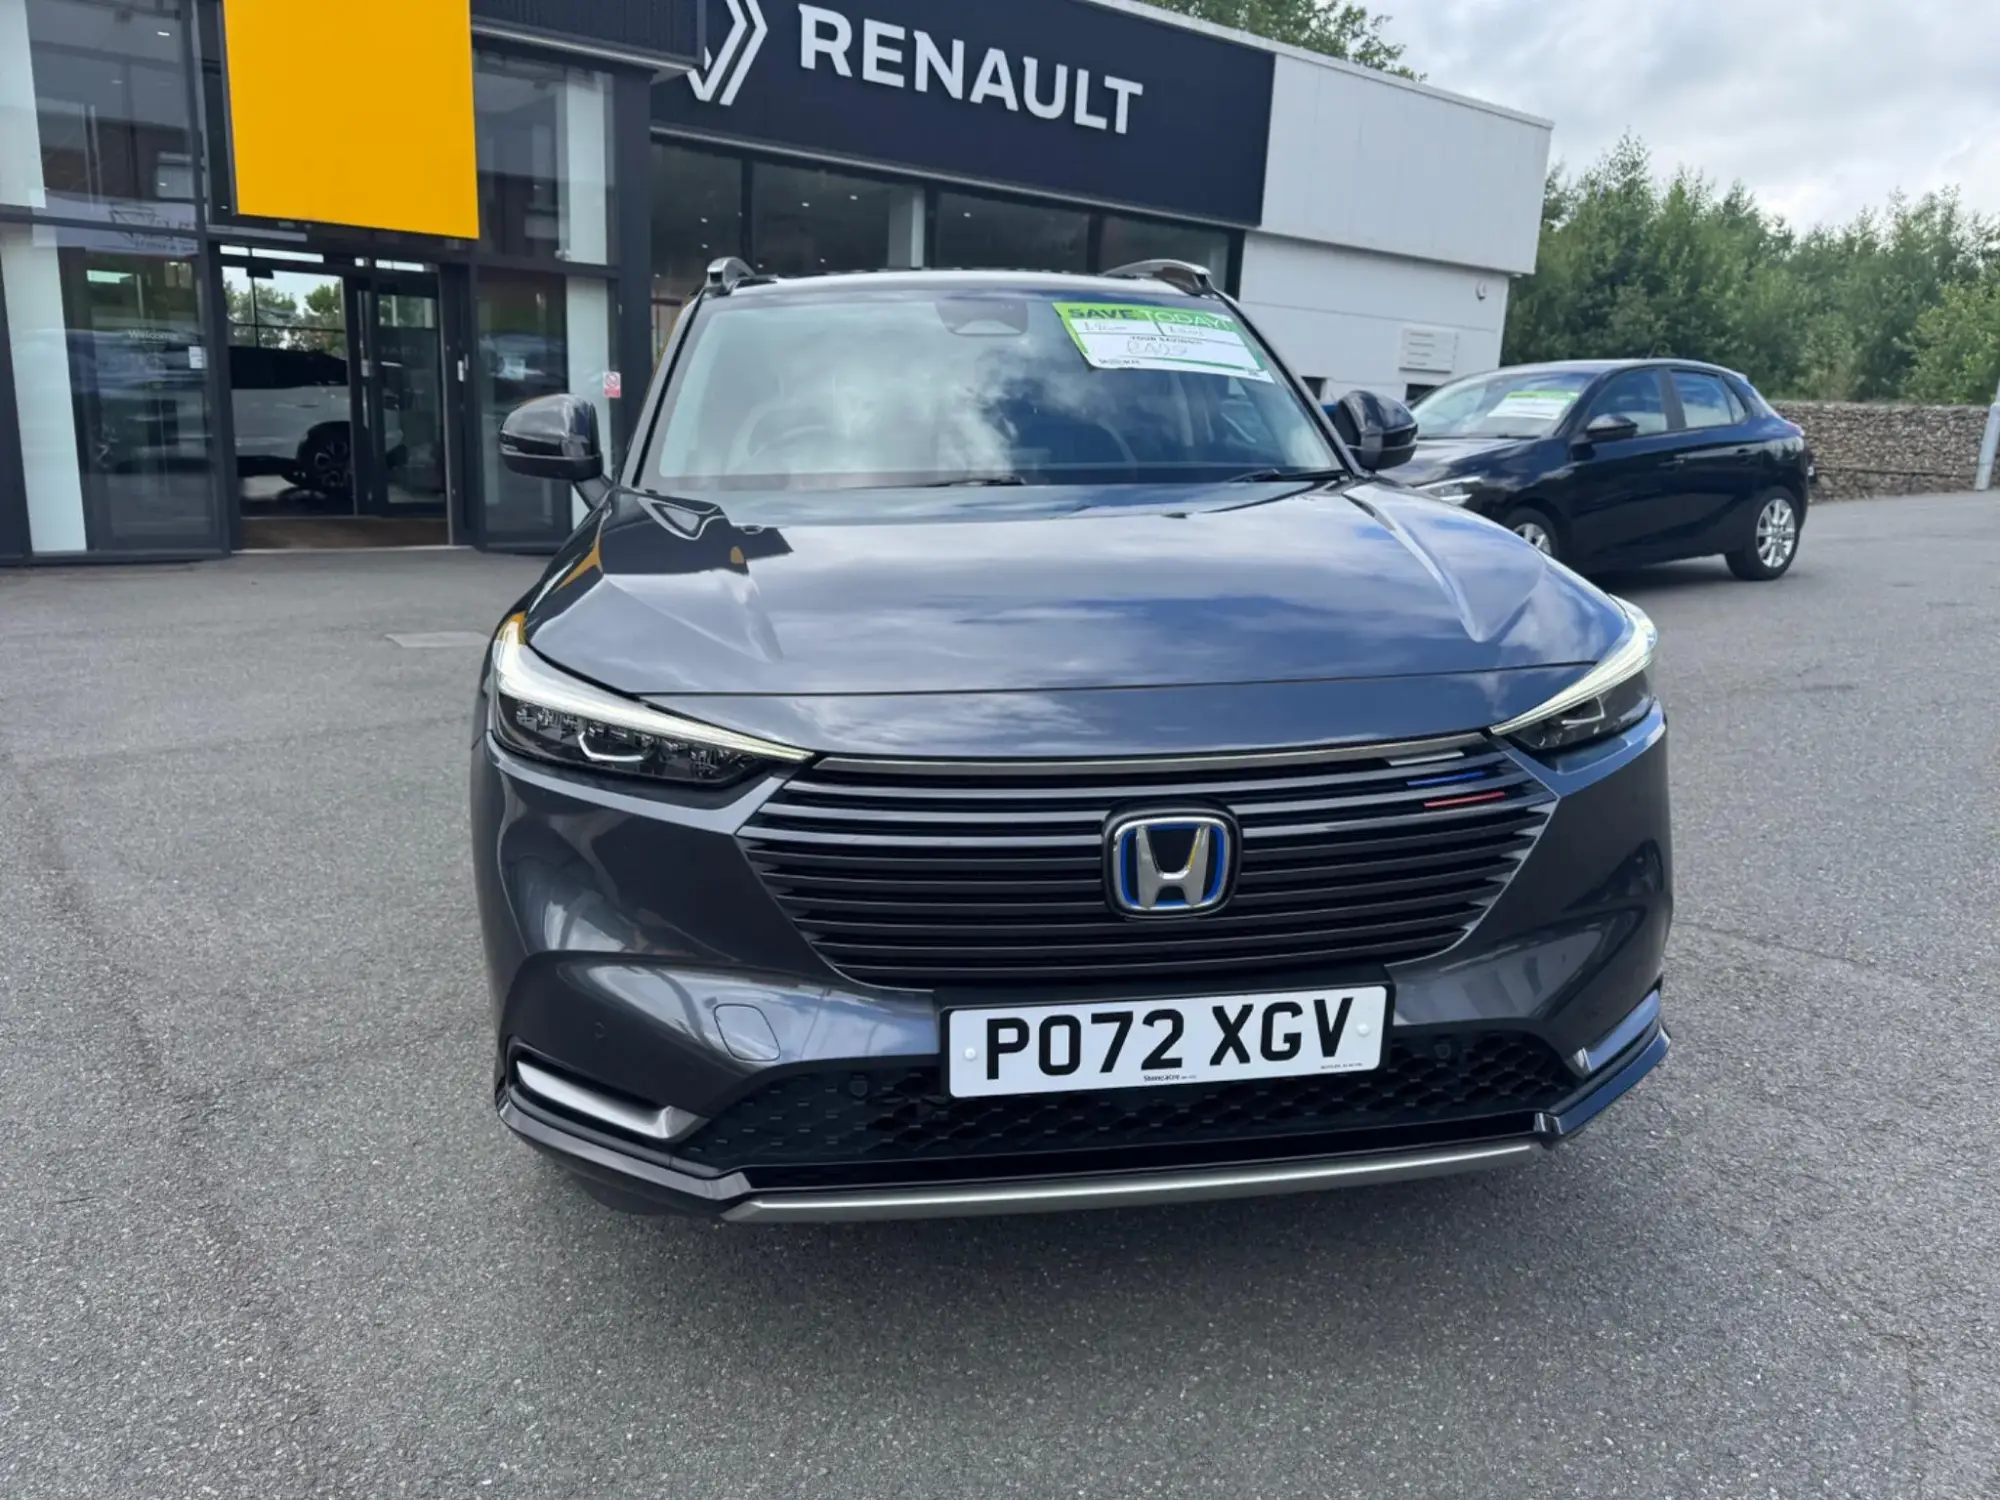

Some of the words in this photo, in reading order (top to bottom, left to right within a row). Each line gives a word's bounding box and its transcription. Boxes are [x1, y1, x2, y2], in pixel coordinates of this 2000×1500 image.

[797, 3, 1144, 135] RENAULT
[1067, 308, 1138, 320] SAVE
[985, 1008, 1185, 1080] PO72
[1209, 996, 1355, 1067] XGV
